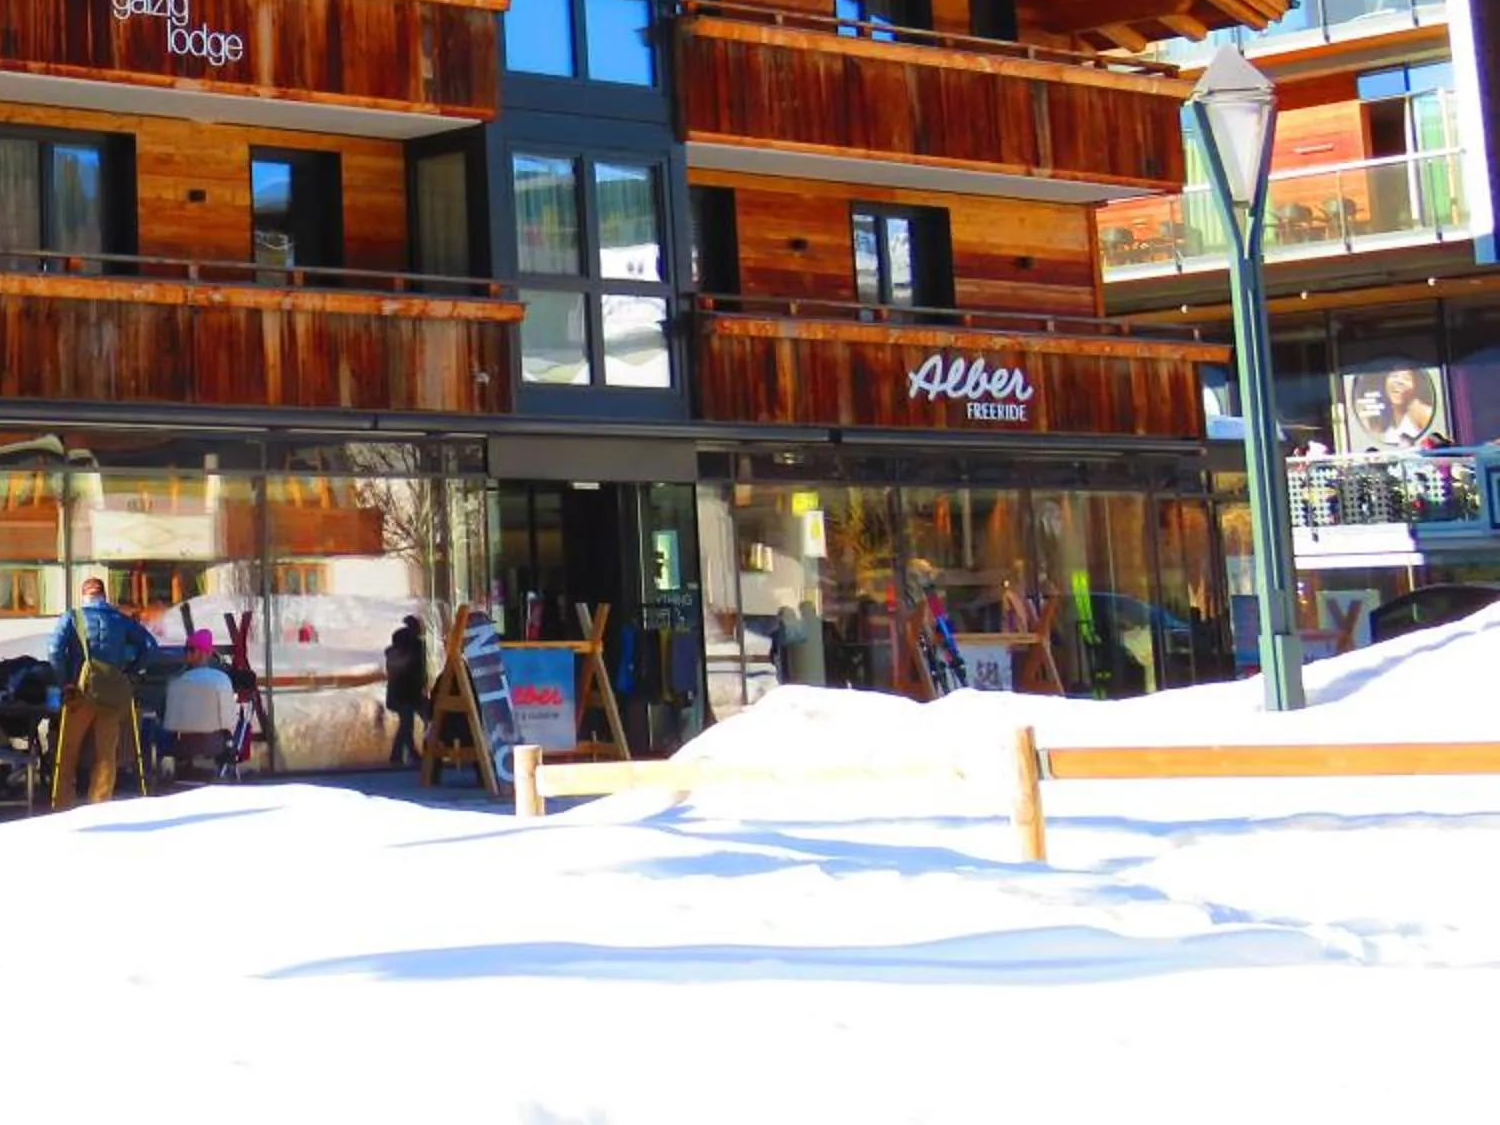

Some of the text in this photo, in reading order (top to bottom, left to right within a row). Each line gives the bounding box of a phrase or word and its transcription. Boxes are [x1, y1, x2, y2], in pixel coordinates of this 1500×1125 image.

[167, 18, 244, 67] lodge
[907, 354, 1035, 402] Alber
[966, 401, 1029, 422] FREERIDE
